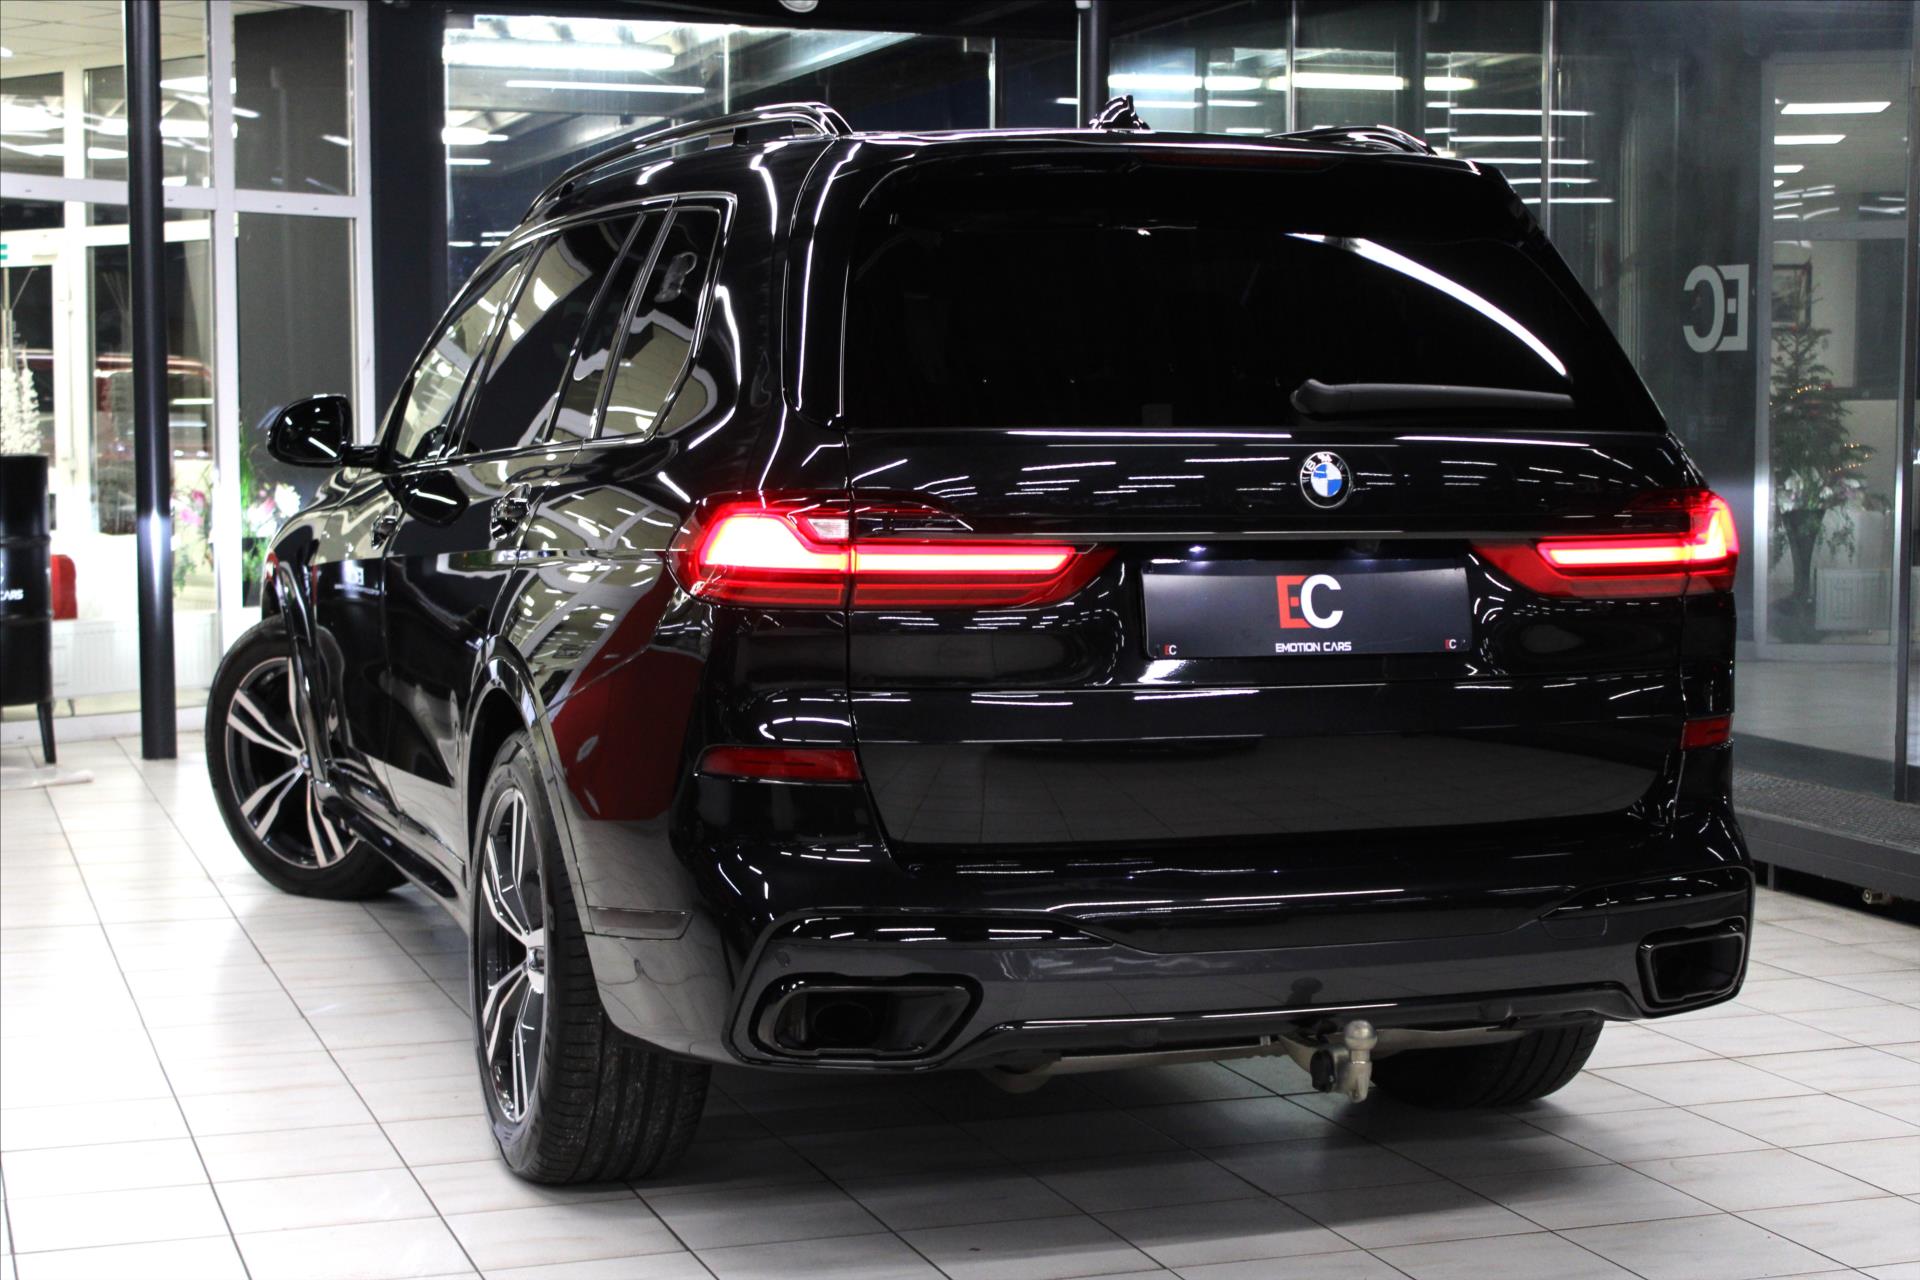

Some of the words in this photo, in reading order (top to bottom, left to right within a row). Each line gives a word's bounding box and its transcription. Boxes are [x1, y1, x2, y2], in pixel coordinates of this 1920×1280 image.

[1276, 574, 1344, 629] EC
[1275, 642, 1321, 653] EMOTION
[1323, 641, 1352, 652] CARS
